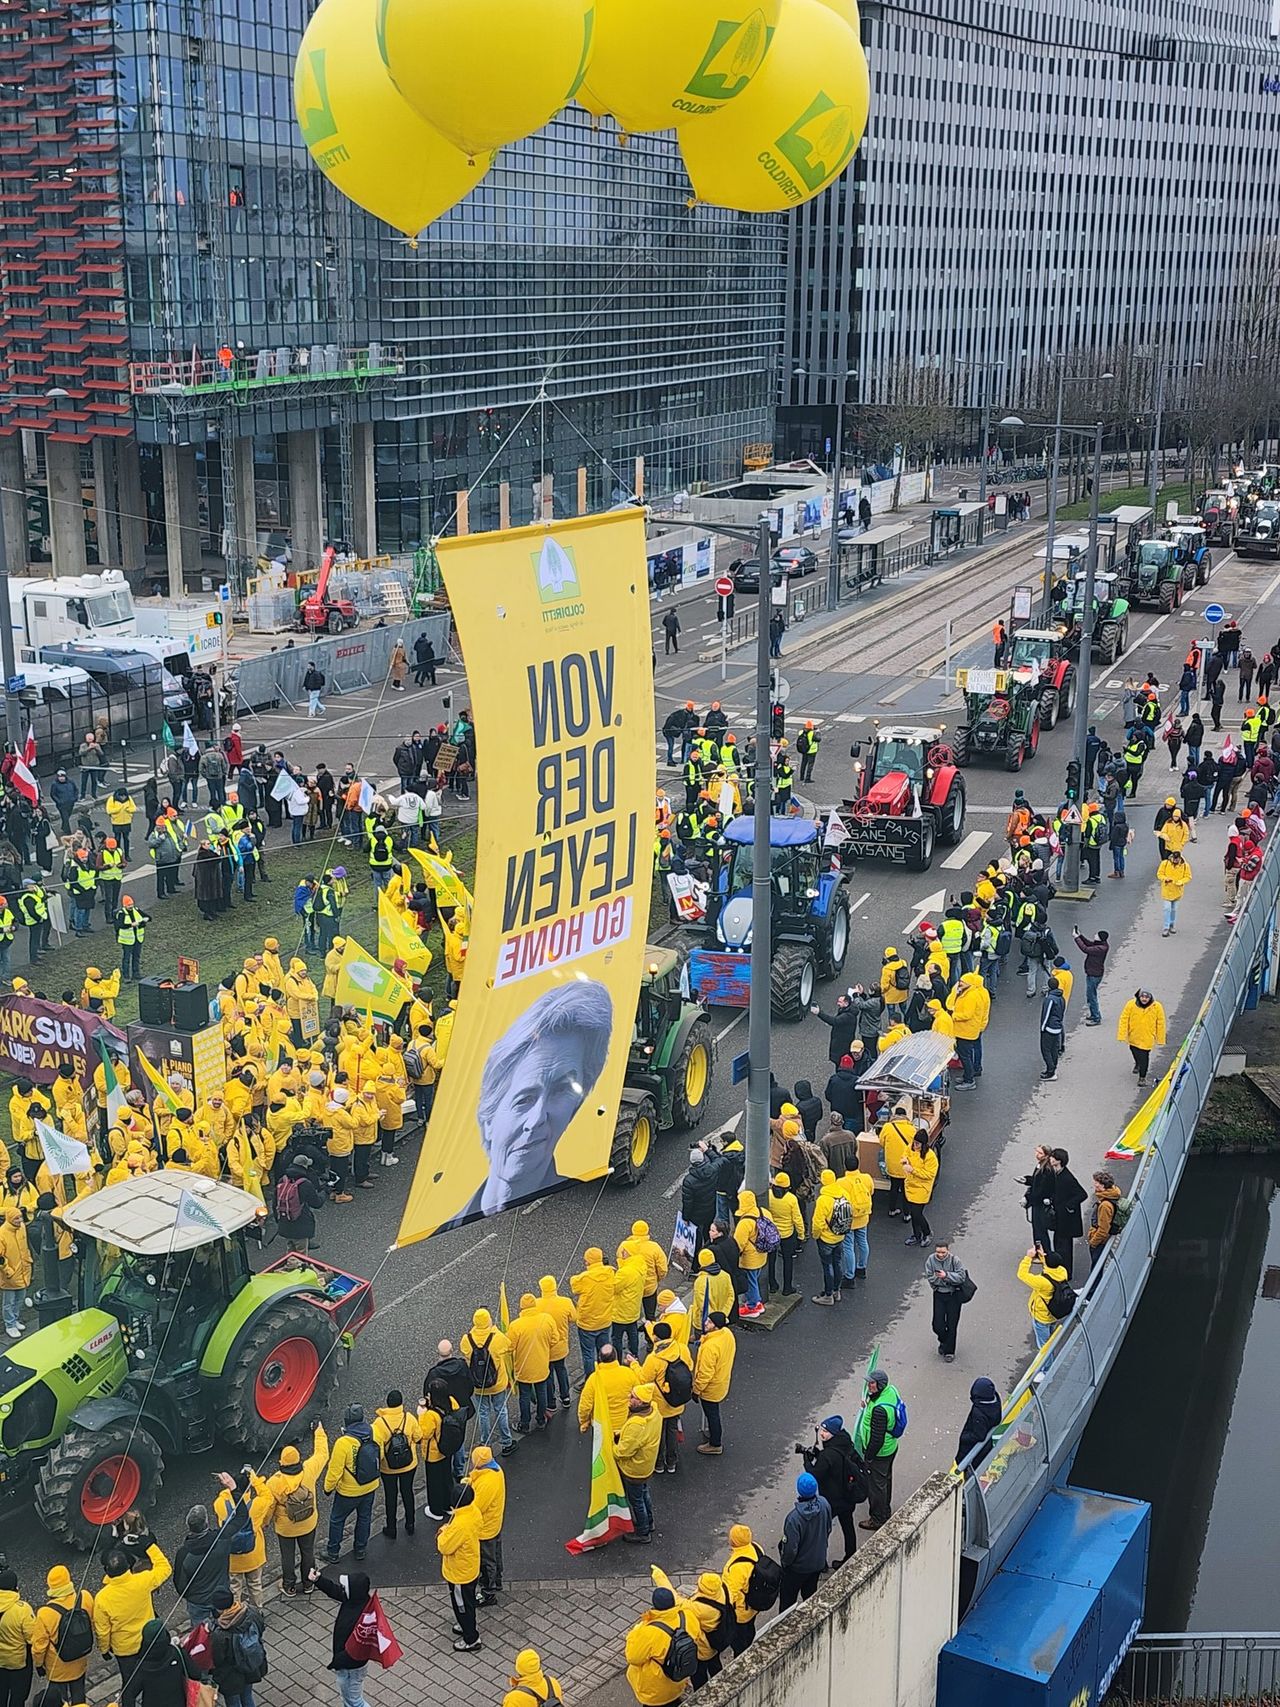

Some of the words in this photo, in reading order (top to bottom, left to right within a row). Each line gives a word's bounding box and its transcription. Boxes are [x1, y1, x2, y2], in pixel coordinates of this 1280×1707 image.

[1180, 610, 1233, 620] BS
[1105, 680, 1170, 692] BS
[885, 820, 921, 845] PAYS
[837, 842, 905, 860] PAYSANS
[170, 1059, 193, 1074] PIANO
[676, 1220, 695, 1245] NON
[89, 1330, 113, 1350] CLAAS
